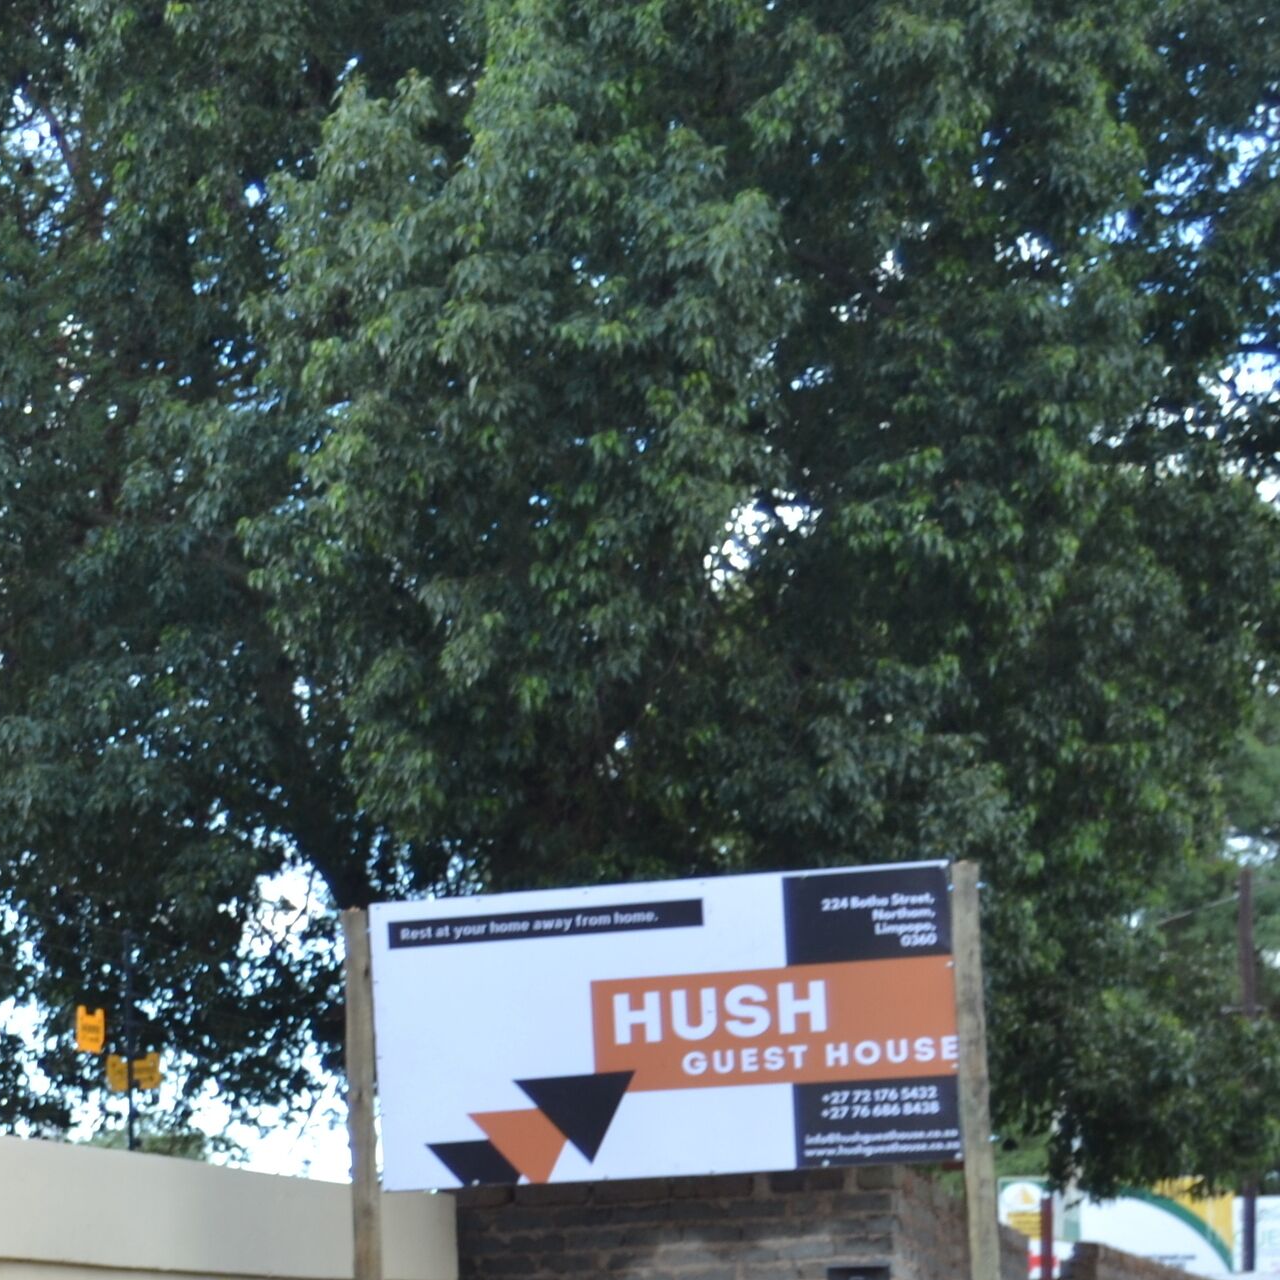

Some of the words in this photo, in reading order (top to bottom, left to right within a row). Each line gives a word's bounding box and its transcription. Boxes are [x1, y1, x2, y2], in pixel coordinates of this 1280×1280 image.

[821, 897, 849, 911] 224
[400, 927, 432, 940] Rest
[435, 927, 450, 938] at
[454, 925, 486, 940] your
[490, 920, 530, 935] home
[533, 915, 573, 932] away
[575, 912, 611, 928] from
[614, 910, 659, 925] home.
[613, 980, 827, 1045] HUSH
[682, 1045, 808, 1076] GUEST
[826, 1035, 960, 1067] HOUSE
[822, 1090, 850, 1105] +27
[852, 1089, 872, 1103] 72
[873, 1087, 899, 1102] 176
[821, 1105, 849, 1120] +27
